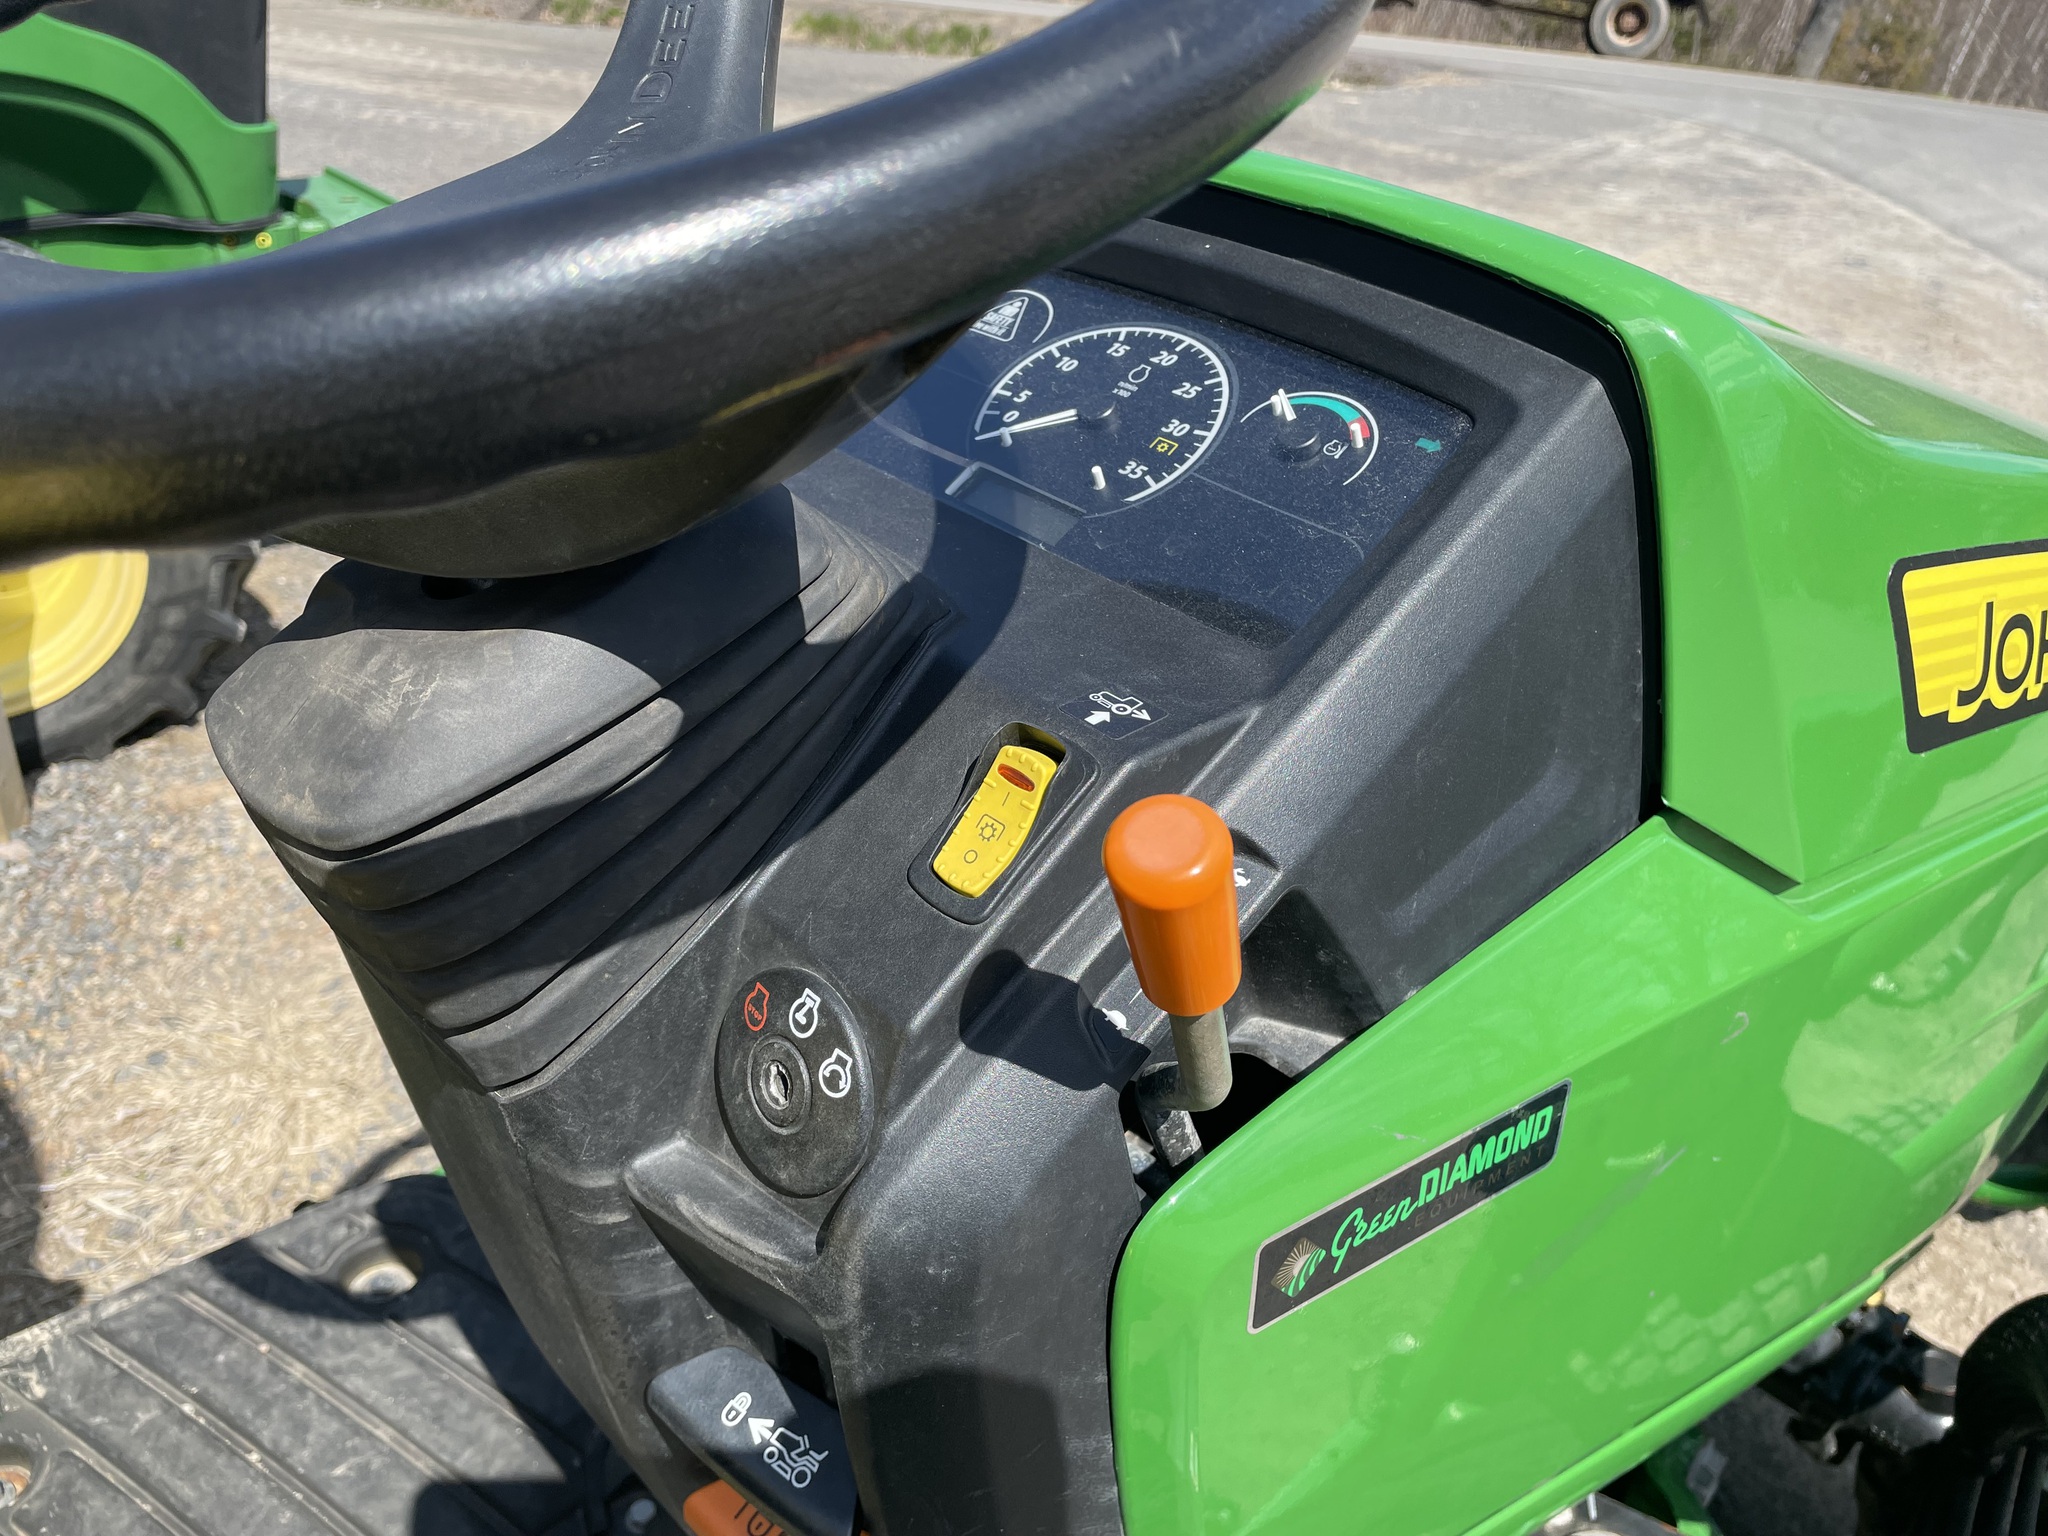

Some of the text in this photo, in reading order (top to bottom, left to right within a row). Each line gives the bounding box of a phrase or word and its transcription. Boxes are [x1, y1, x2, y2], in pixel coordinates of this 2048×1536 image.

[1106, 342, 1131, 357] 15
[1149, 350, 1179, 366] 20
[1055, 356, 1079, 372] 10
[1012, 389, 1033, 403] 5
[1171, 381, 1203, 399] 25
[1002, 410, 1020, 423] 0
[1160, 418, 1191, 437] 30
[1117, 460, 1149, 479] 35
[747, 1002, 763, 1021] STOP
[1416, 1105, 1554, 1208] DIAMOND
[1413, 1145, 1547, 1229] EQUIPMENT
